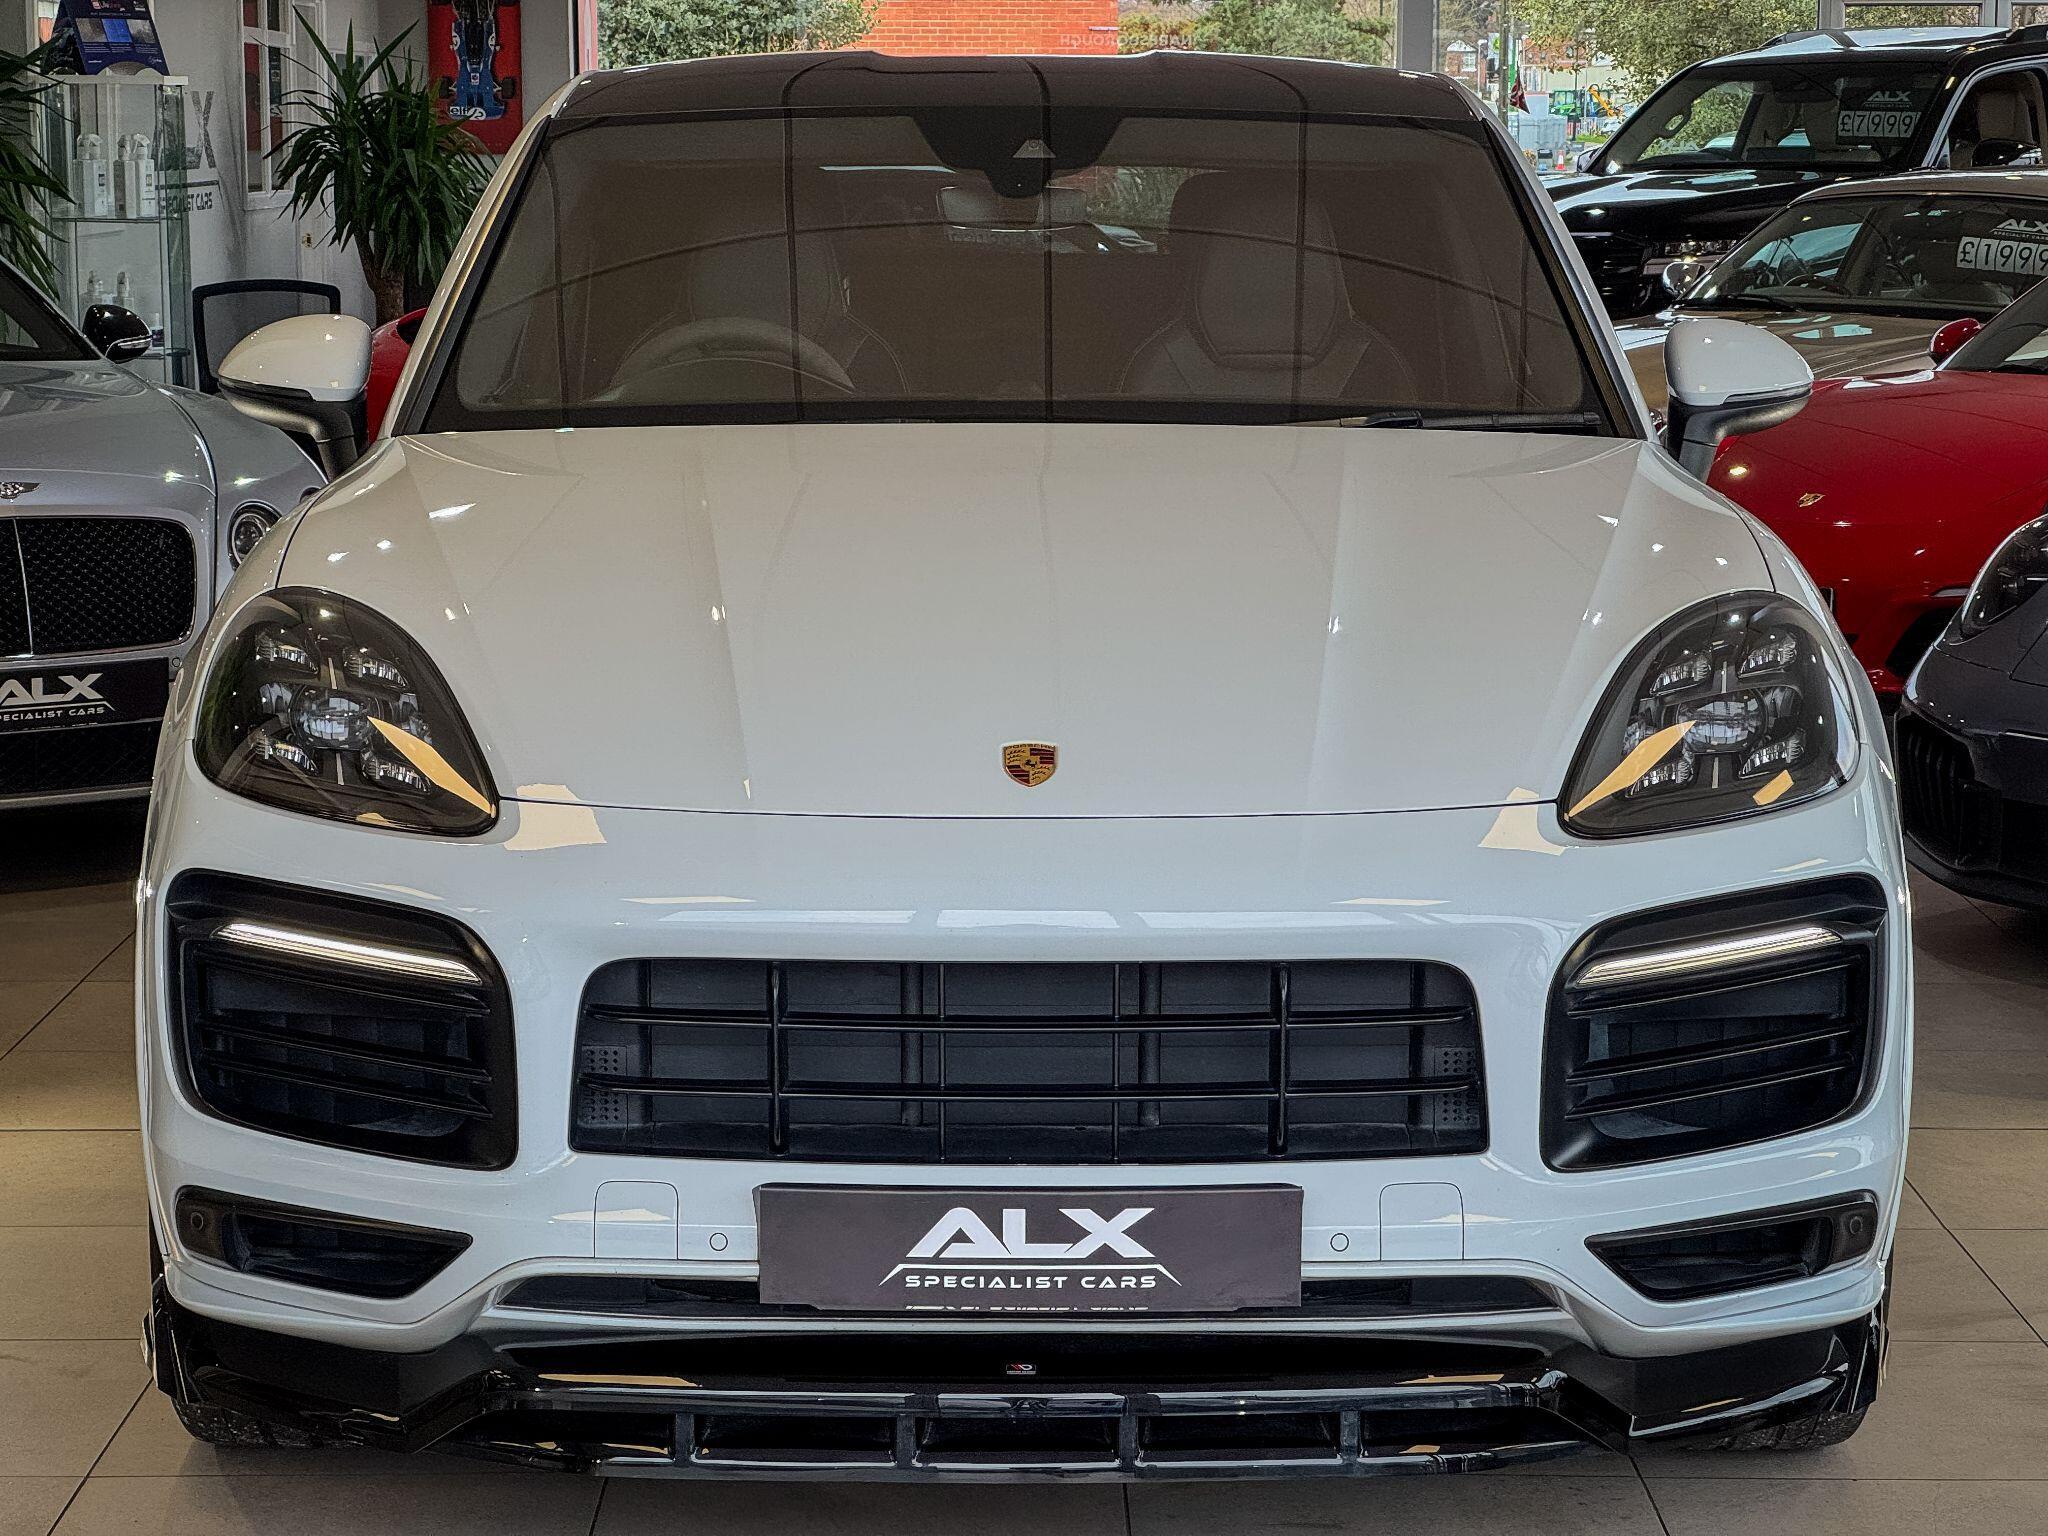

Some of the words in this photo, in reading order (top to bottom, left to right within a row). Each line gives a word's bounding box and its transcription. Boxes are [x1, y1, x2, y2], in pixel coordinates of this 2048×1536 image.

[1867, 91, 1911, 101] ALX
[1840, 114, 1913, 133] £7999
[0, 673, 104, 706] ALX
[0, 711, 62, 721] ECIALIST
[68, 707, 104, 717] CARS
[906, 1207, 1156, 1258] ALX
[905, 1275, 1068, 1289] SPECIALIST
[1081, 1275, 1156, 1289] CARS
